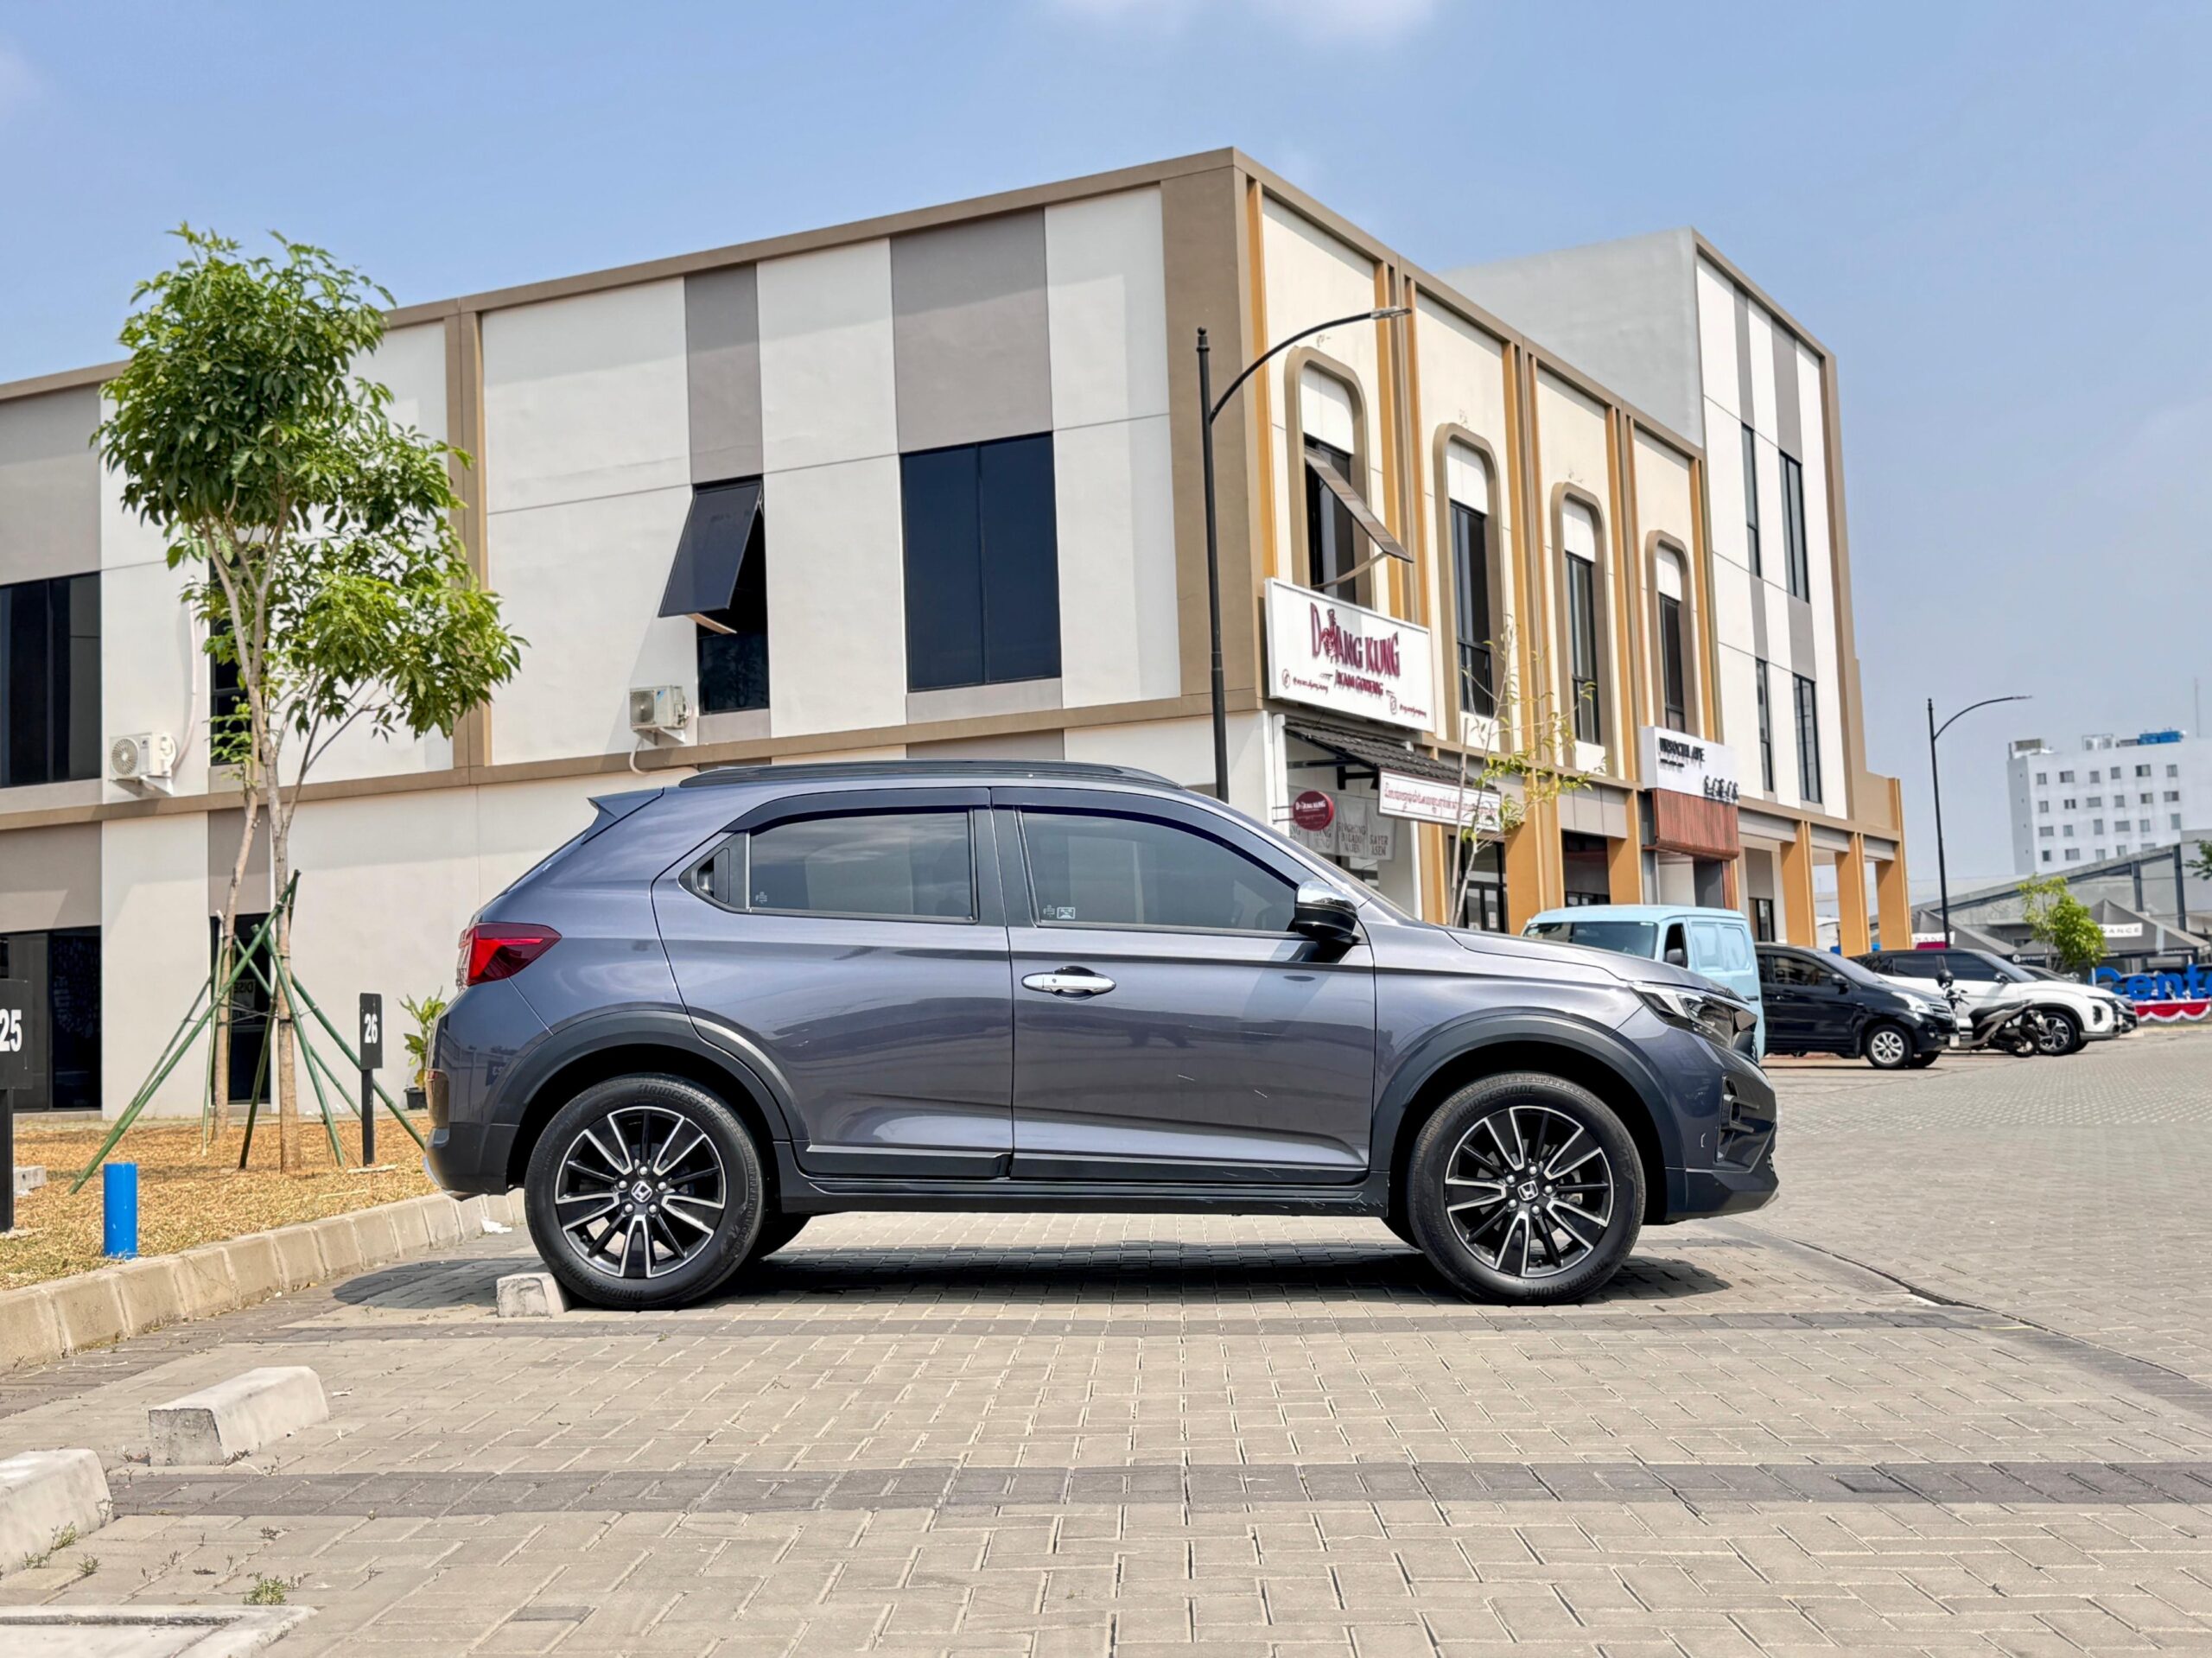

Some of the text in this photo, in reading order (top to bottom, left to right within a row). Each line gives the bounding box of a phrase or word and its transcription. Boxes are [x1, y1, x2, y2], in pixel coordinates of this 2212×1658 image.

[1364, 631, 1401, 678] KUNG
[0, 1008, 22, 1051] 25
[364, 1013, 378, 1044] 26
[637, 1083, 721, 1125] BRIDGESTONE
